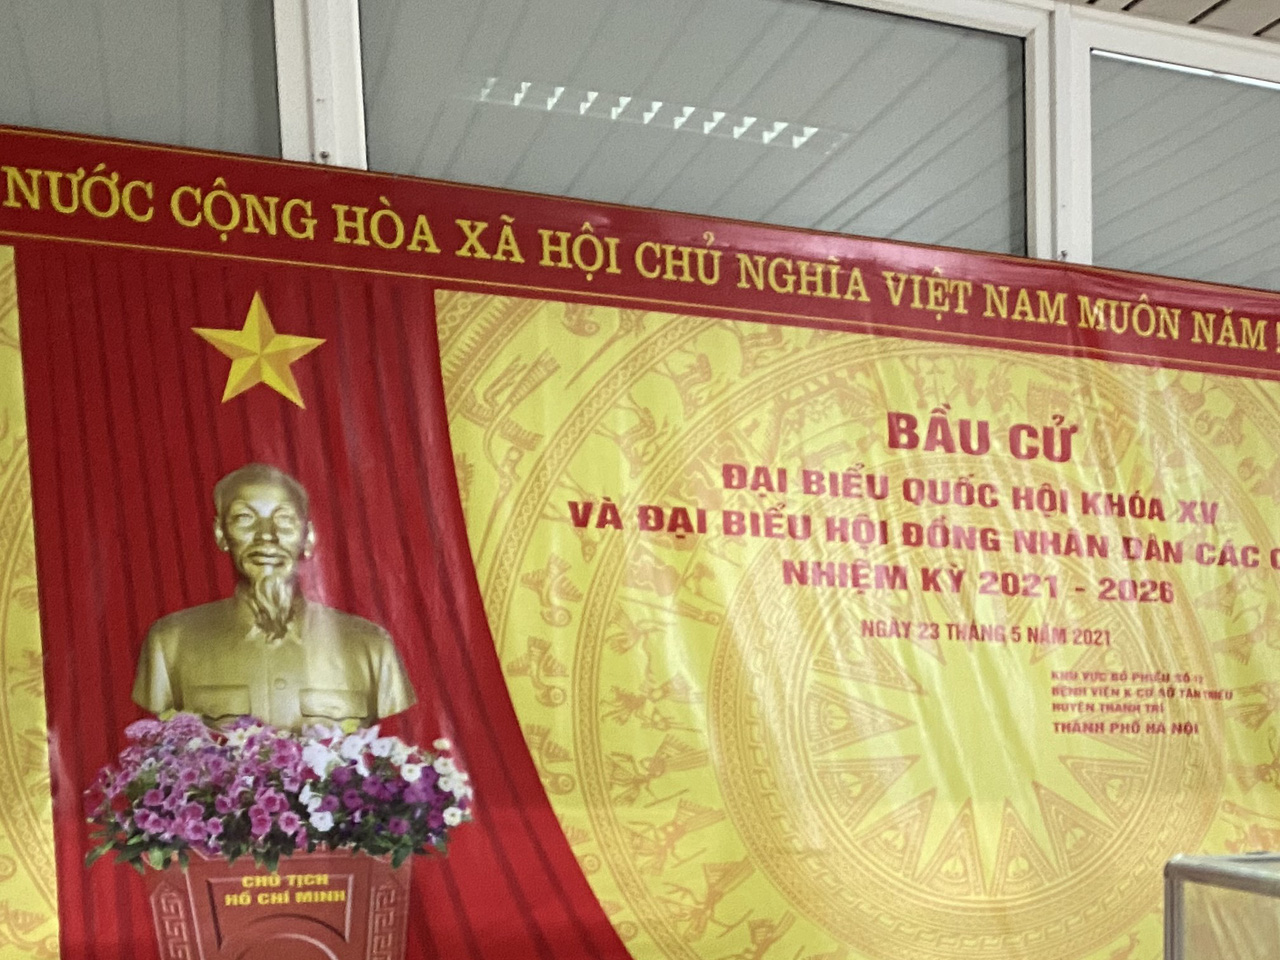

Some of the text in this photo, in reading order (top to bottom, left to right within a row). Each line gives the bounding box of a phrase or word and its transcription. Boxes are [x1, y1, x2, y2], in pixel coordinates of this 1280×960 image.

[1, 163, 154, 222] NƯỚC
[170, 177, 317, 242] CỘNG
[332, 196, 441, 253] HÒA
[455, 215, 525, 263] XÃ
[538, 222, 622, 281] HỘI
[635, 231, 723, 285] CHỦ
[737, 255, 871, 302] NGHĨA
[881, 267, 972, 321] VIỆT
[983, 284, 1068, 326] NAM
[1078, 294, 1180, 340] MUÔN
[887, 403, 1079, 462] BẦU CỬ
[722, 463, 1219, 525] ĐẠI BIỂU QUỐC HỘI KHÓA XV
[568, 497, 624, 530] VÀ
[637, 505, 707, 539] ĐẠI
[722, 503, 812, 541] BIỂU
[825, 513, 889, 550] HỘI
[902, 515, 1001, 552] ĐỒNG
[1014, 528, 1109, 559] NHÂN
[1122, 535, 1184, 564] DÂN
[1195, 539, 1261, 569] CÁC
[783, 558, 908, 595] NHIỆM
[921, 562, 966, 595] KỲ
[978, 571, 1059, 599] 2021
[1098, 577, 1175, 604] 2026
[861, 617, 1112, 647] NGÀY 23 THÁNG 5 NĂM 2021
[287, 874, 330, 888] TỊCH
[295, 890, 346, 904] MINH
